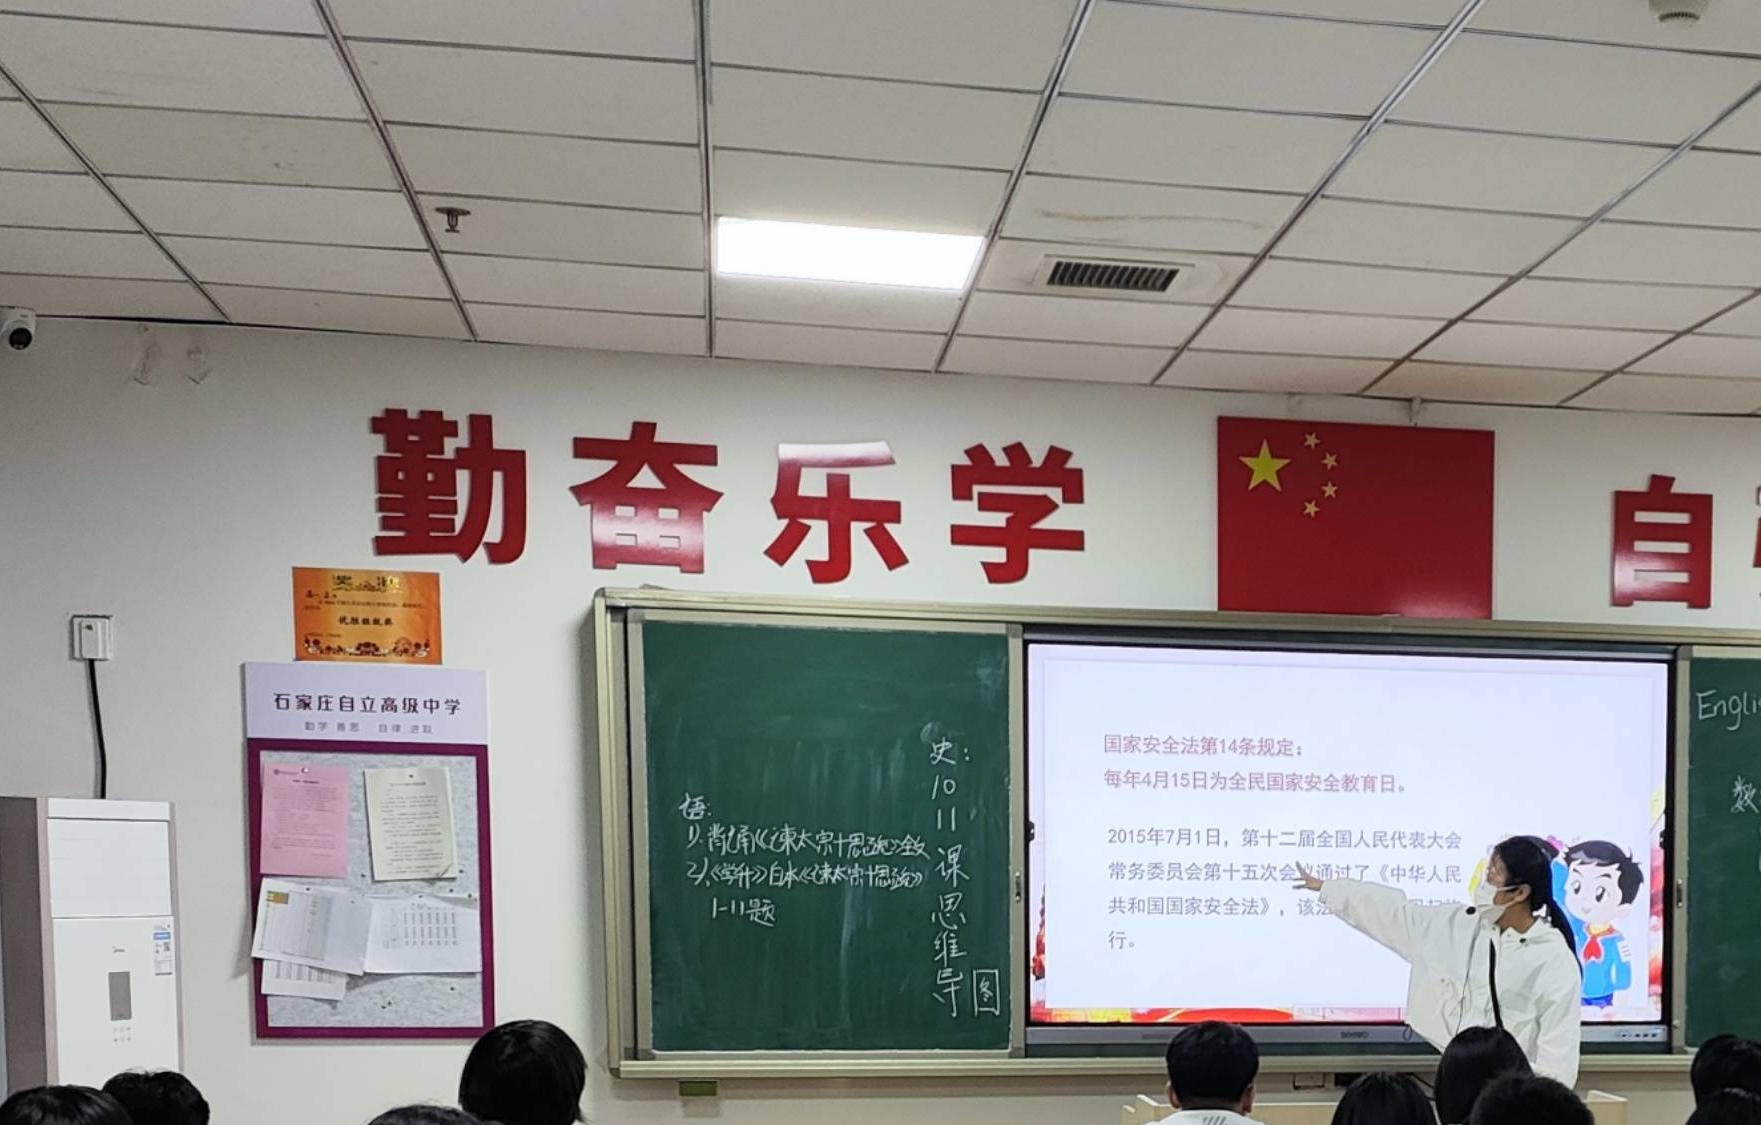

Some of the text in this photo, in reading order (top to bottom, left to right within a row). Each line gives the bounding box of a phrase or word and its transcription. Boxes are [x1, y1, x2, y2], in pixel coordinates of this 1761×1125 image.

[370, 406, 1085, 585] 勤奋乐学
[273, 693, 461, 715] 石家庄自立高级中学
[1104, 768, 1406, 793] 每年4月15日为全民国家安全教育日。
